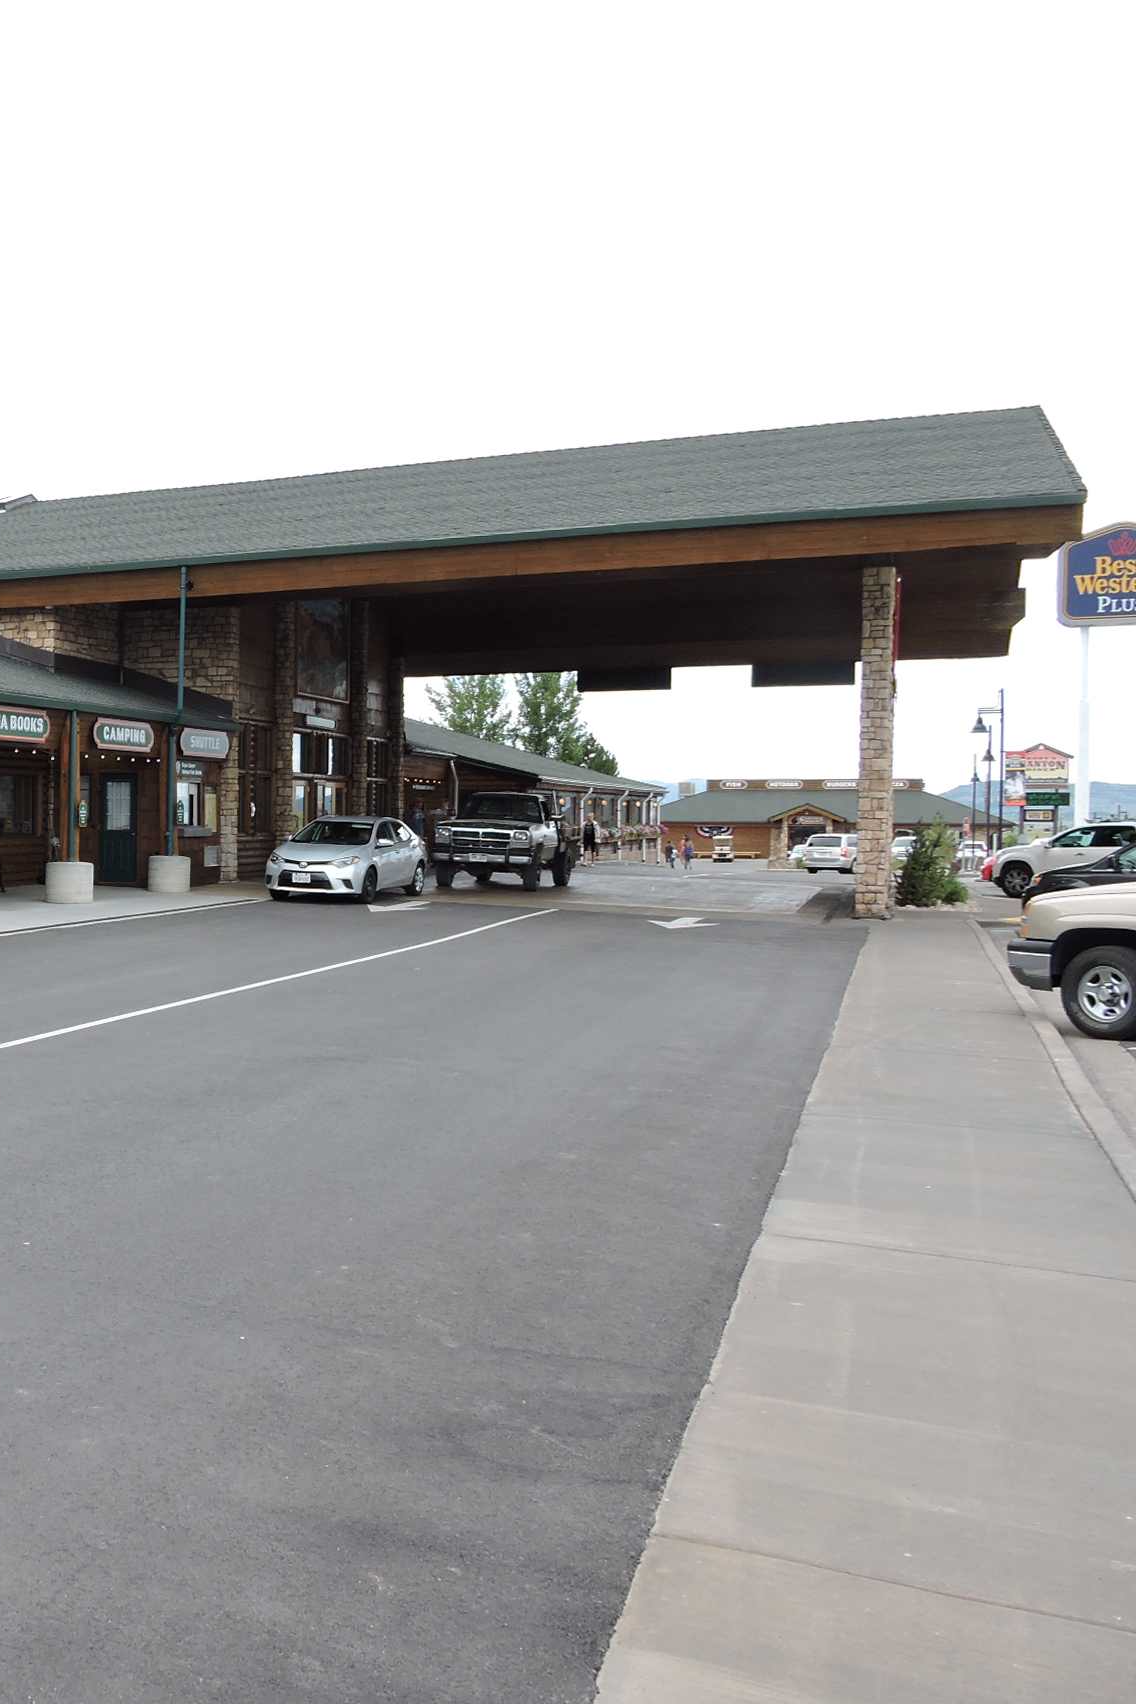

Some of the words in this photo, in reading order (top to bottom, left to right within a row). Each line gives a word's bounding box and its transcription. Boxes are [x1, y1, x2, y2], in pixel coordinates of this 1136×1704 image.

[1097, 595, 1136, 613] PLU
[10, 715, 44, 733] BOOKS
[103, 726, 146, 744] CAMPING
